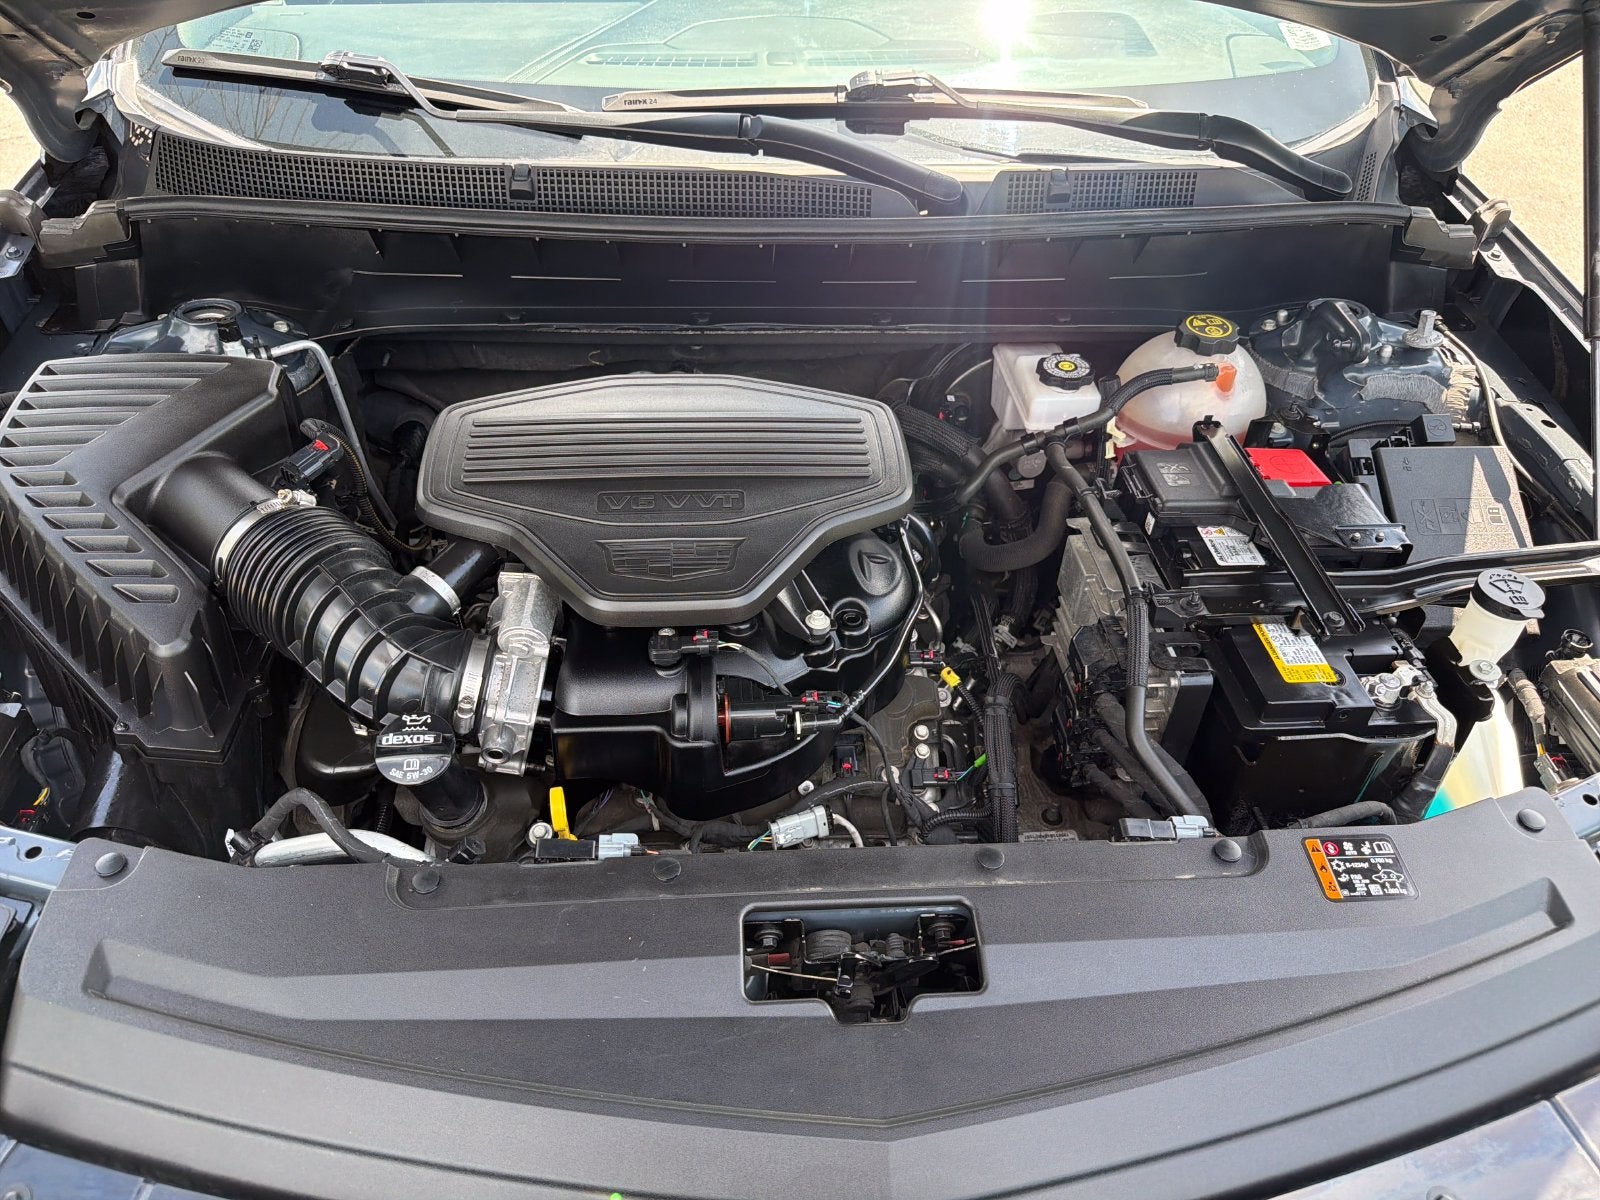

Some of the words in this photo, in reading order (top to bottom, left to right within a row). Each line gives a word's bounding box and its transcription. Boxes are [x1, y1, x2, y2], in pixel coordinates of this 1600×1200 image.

[603, 495, 655, 510] V6
[663, 493, 740, 509] VVT
[381, 733, 436, 745] dexos
[389, 768, 405, 779] SAE
[406, 766, 433, 780] 5W-30
